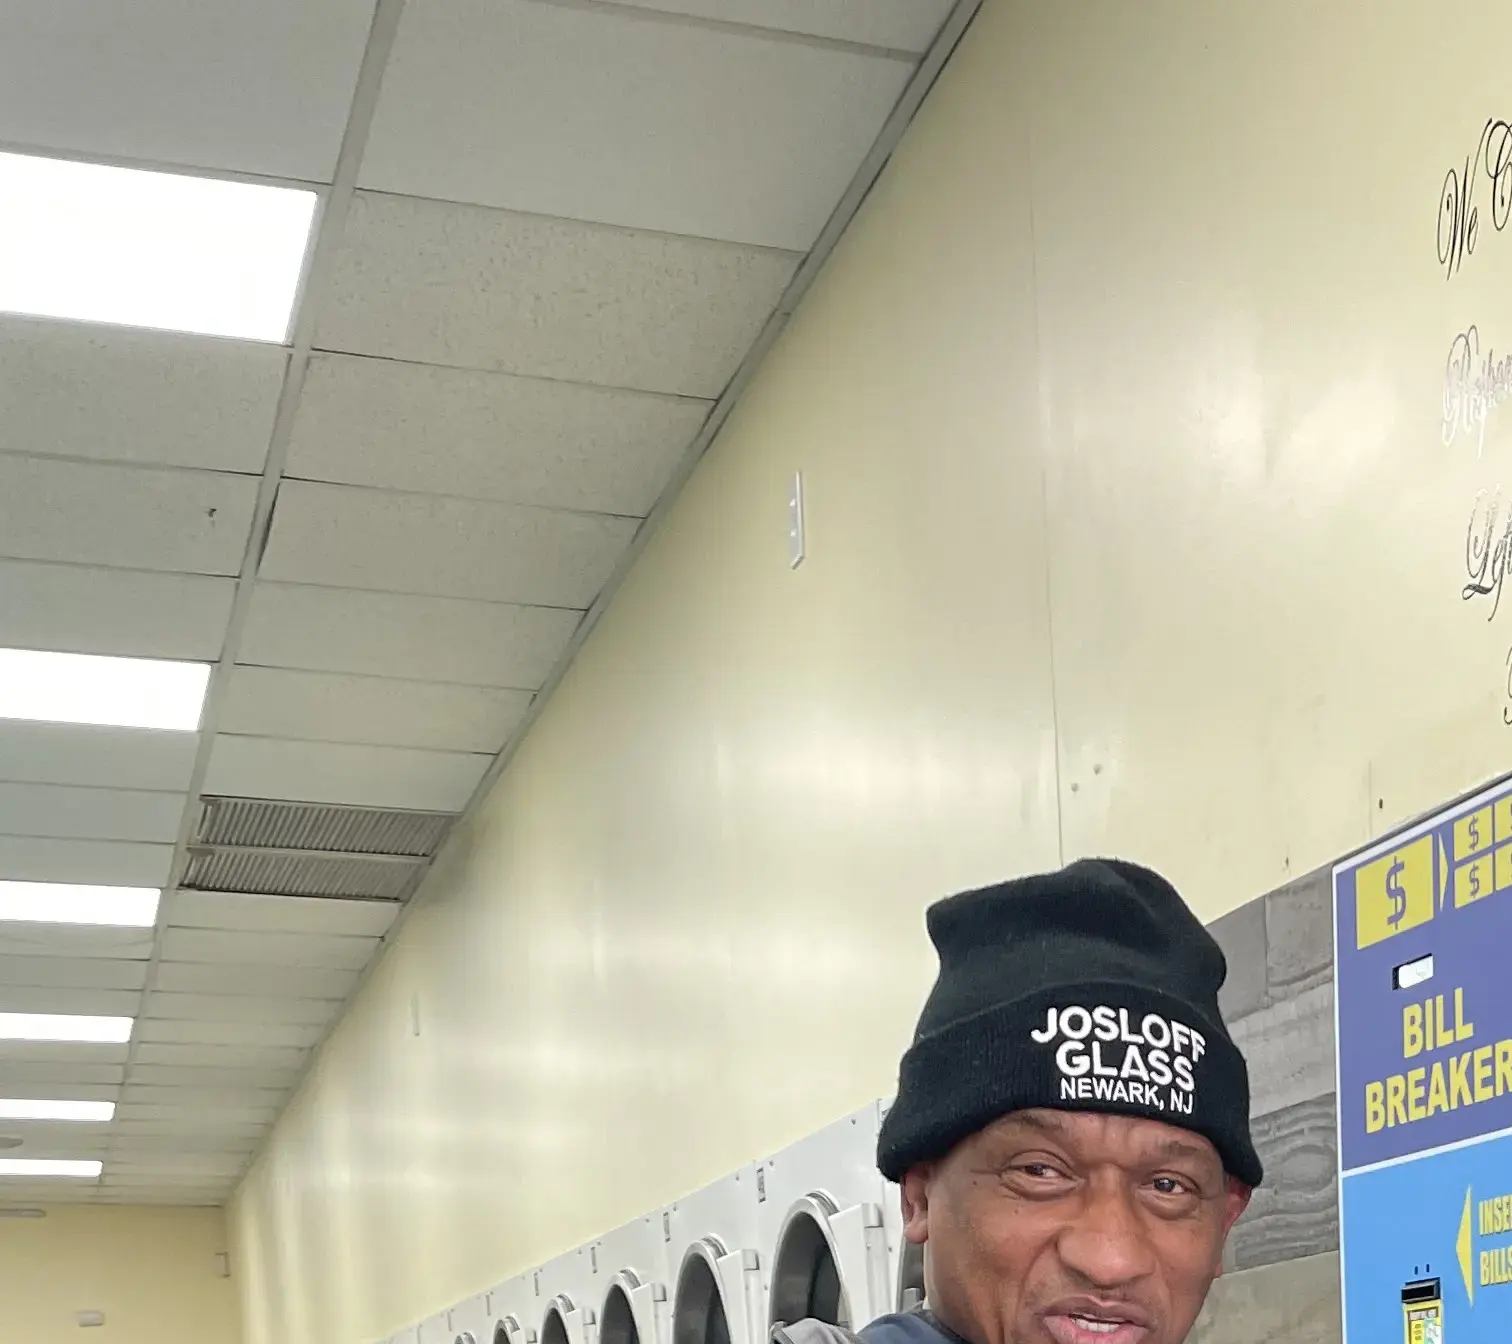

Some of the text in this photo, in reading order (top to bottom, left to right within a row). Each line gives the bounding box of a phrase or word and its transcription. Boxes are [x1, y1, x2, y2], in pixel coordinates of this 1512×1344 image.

[1437, 117, 1492, 281] We
[1385, 855, 1407, 931] $
[1030, 1005, 1207, 1063] JOSLOFF
[1403, 987, 1473, 1058] BILL
[1055, 1040, 1195, 1092] GLASS
[1060, 1076, 1193, 1115] NEWARK, NJ
